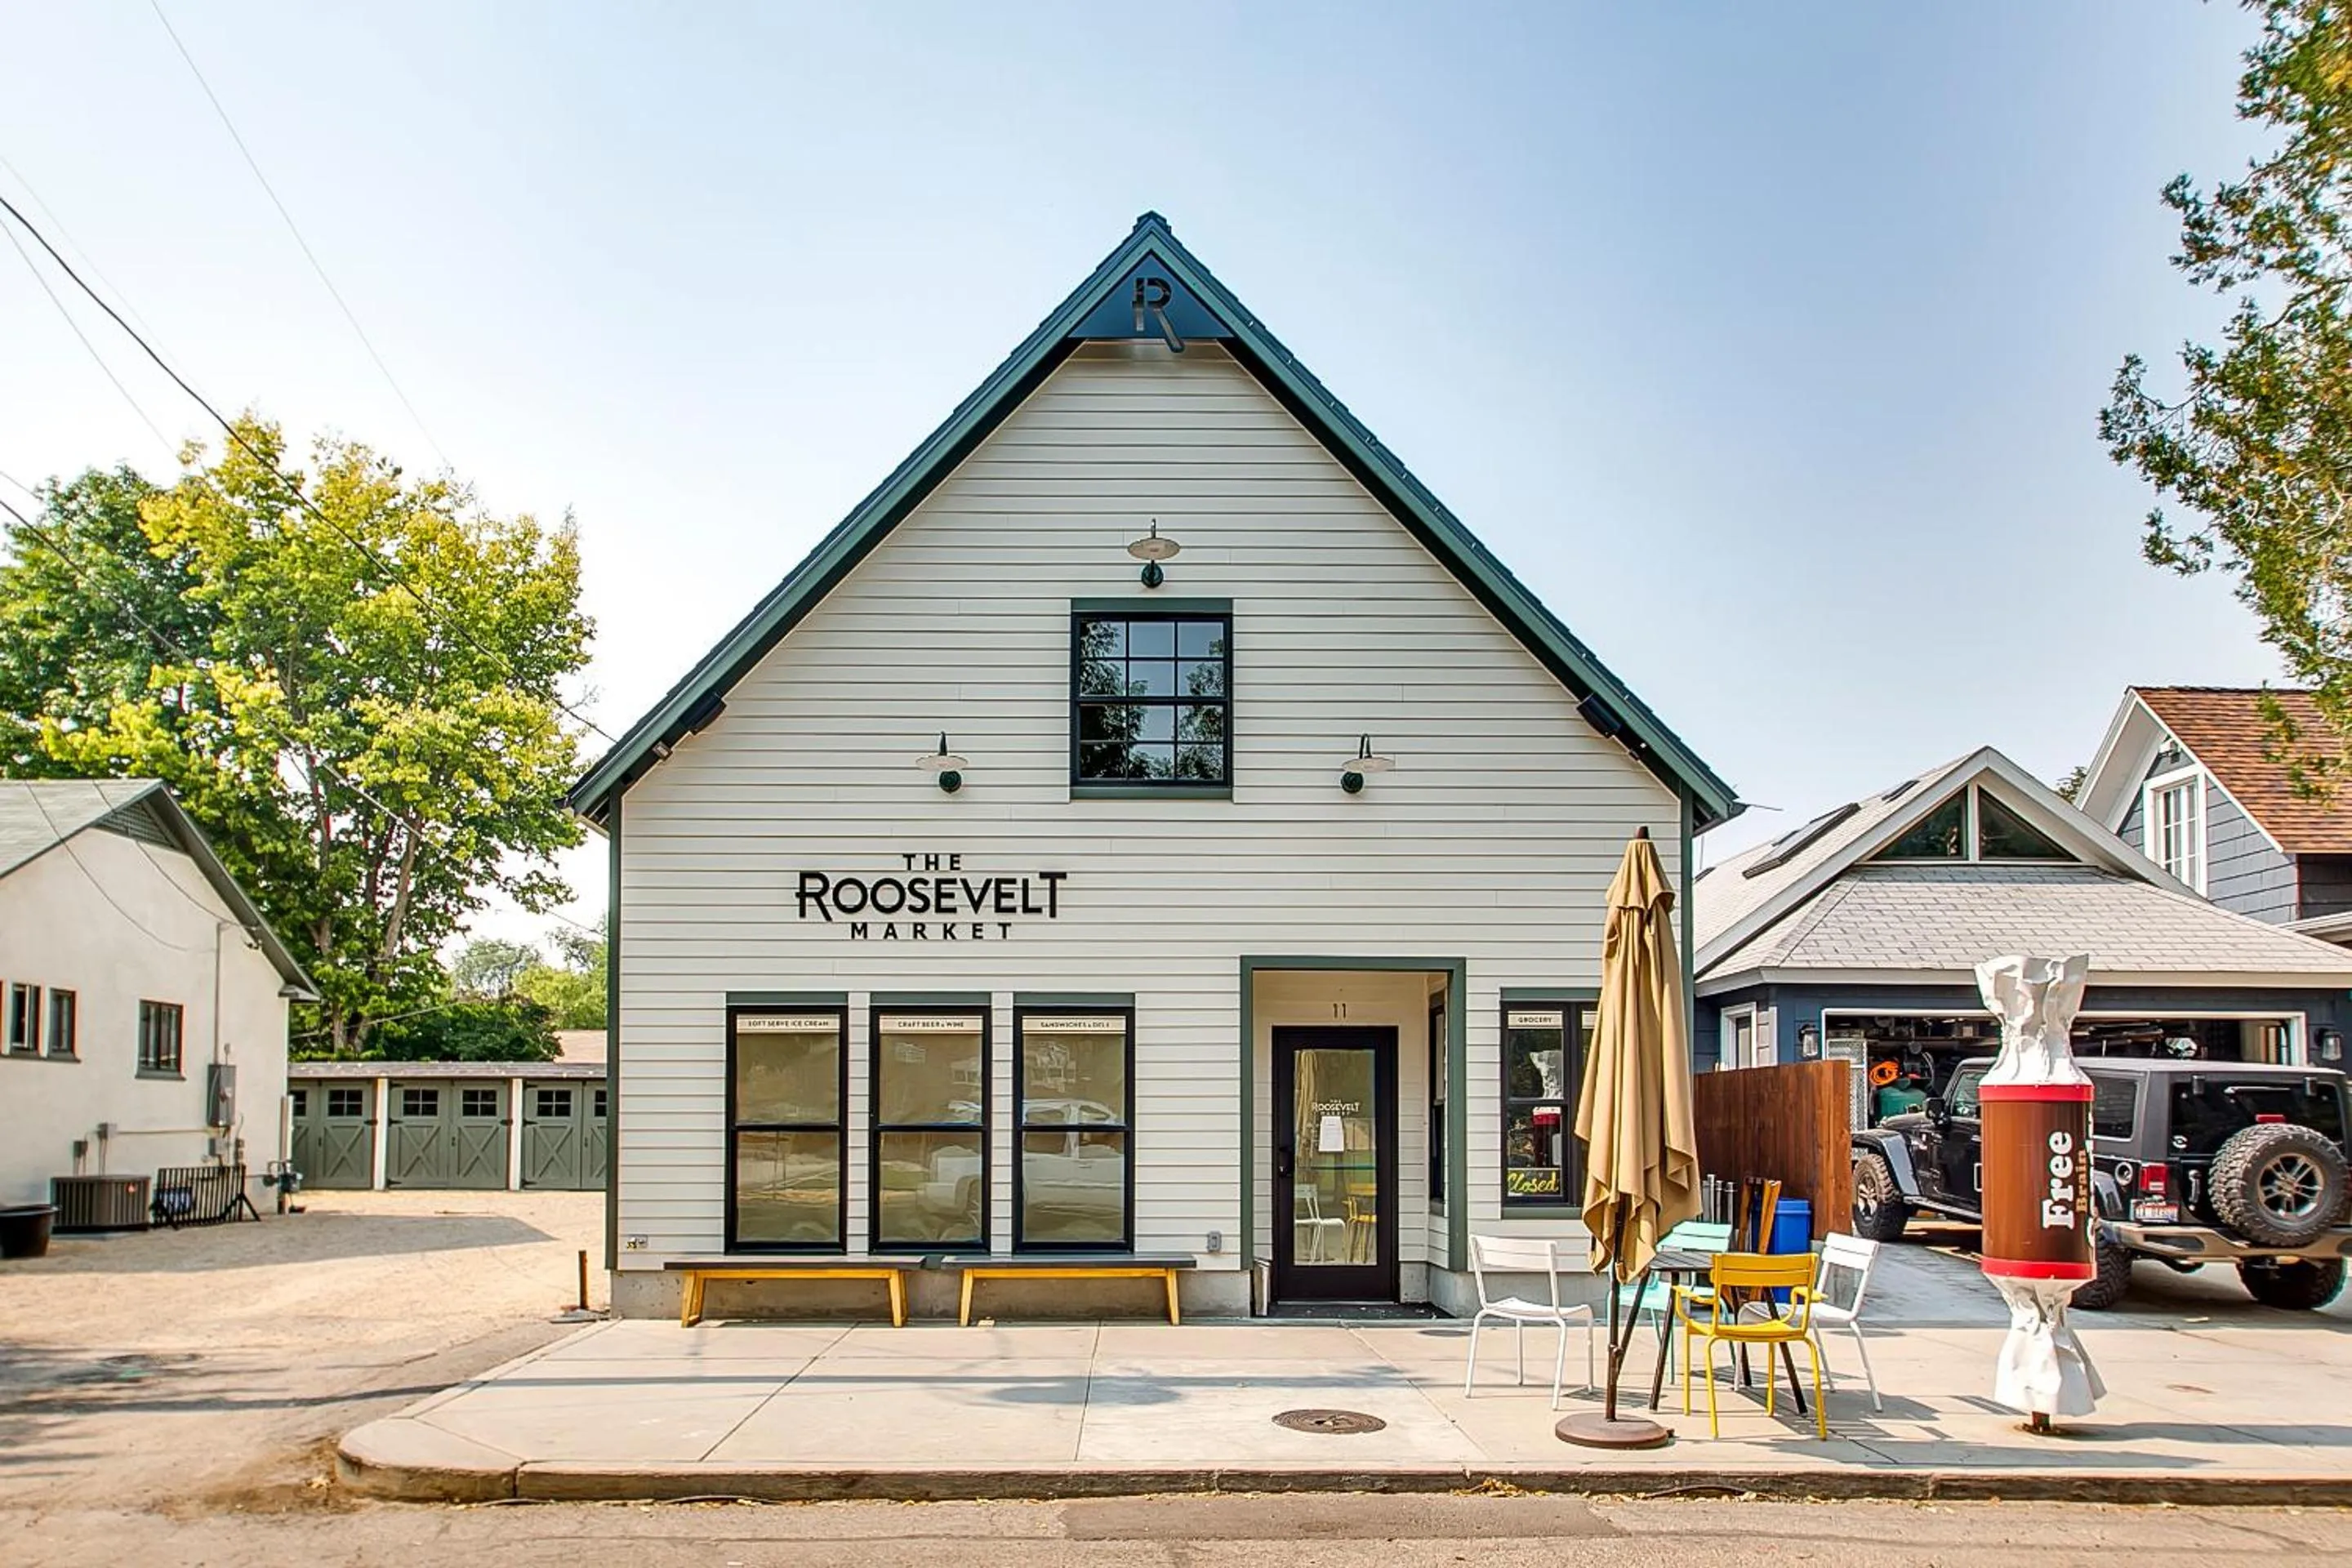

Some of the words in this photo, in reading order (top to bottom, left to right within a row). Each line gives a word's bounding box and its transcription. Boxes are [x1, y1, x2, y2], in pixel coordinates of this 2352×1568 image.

[1132, 277, 1184, 353] R
[902, 853, 962, 871] THE
[795, 871, 1067, 922] ROOSEVELT
[850, 922, 1012, 940] MARKET
[1313, 1102, 1360, 1111] ROOSEVELT
[1508, 1171, 1558, 1192] Closed
[2042, 1130, 2075, 1230] Free
